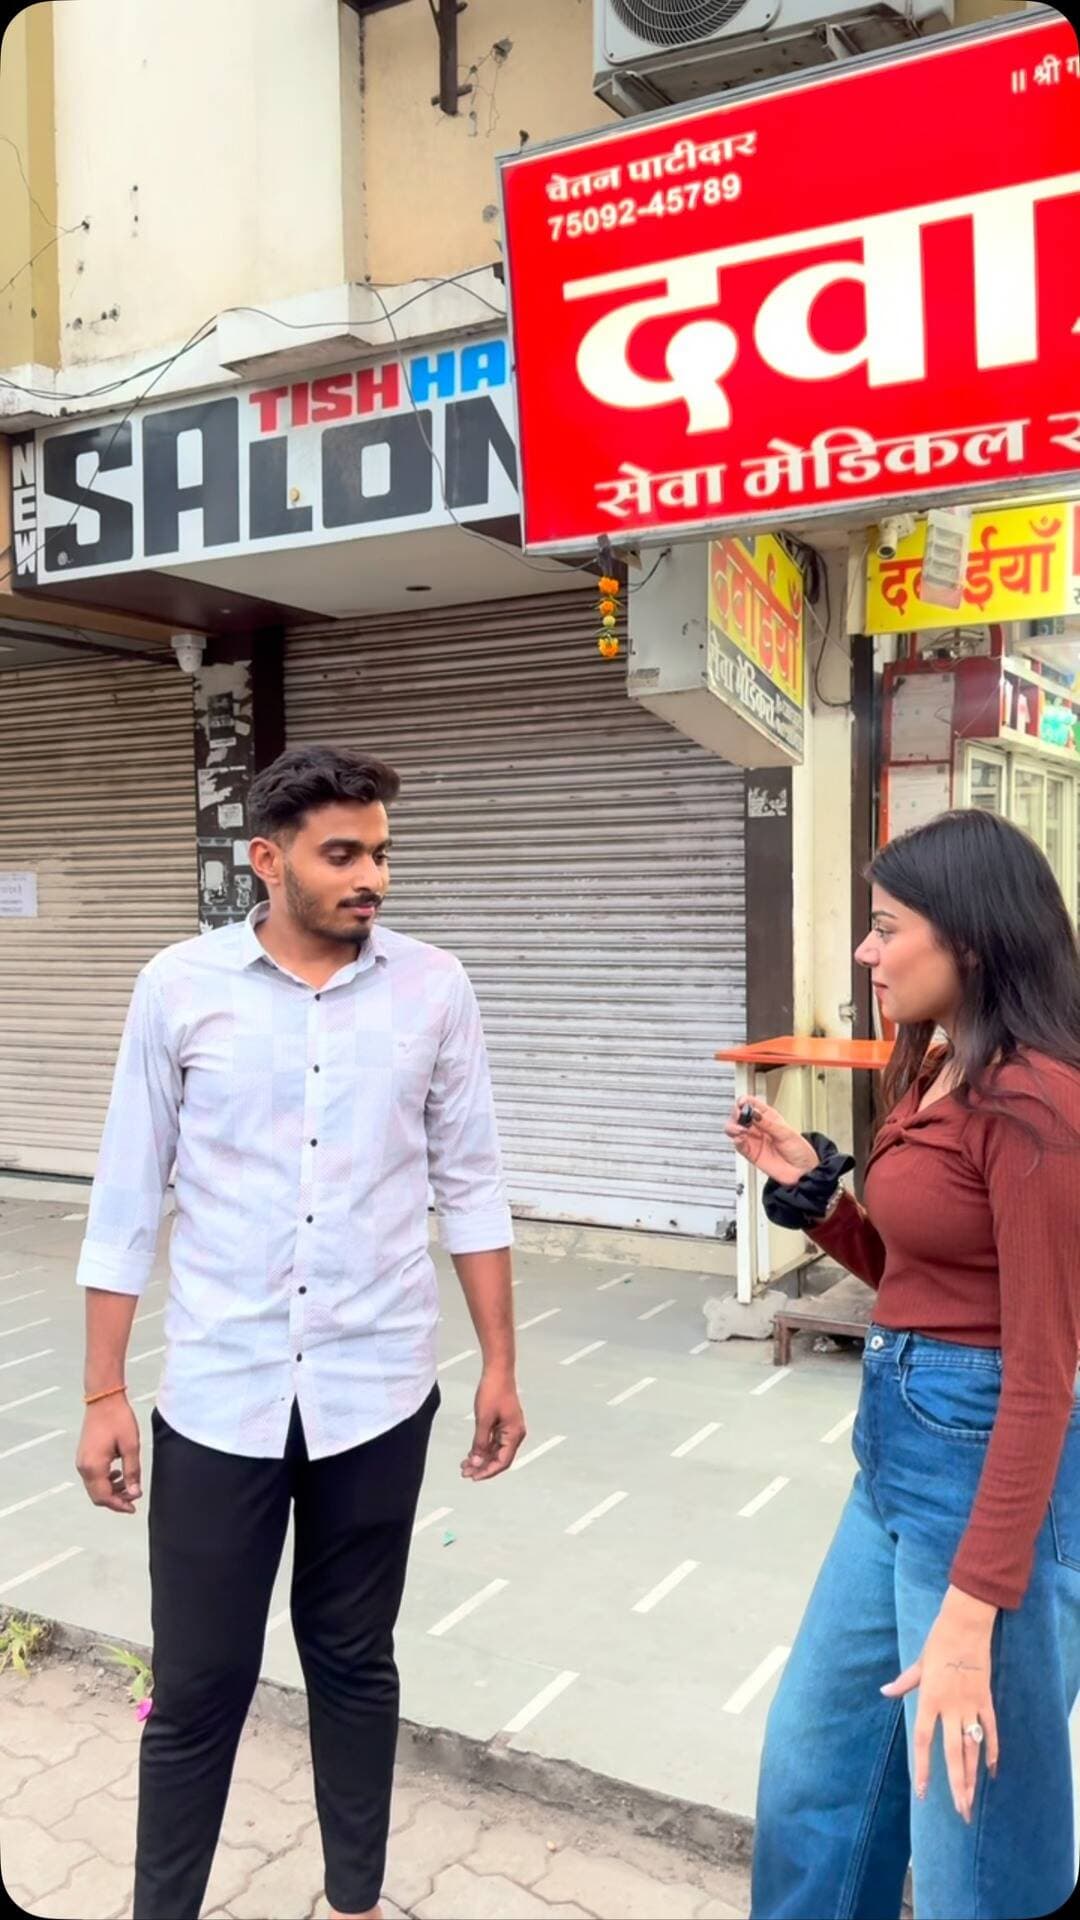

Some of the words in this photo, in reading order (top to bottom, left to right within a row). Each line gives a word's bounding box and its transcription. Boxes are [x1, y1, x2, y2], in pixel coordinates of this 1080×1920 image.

[1033, 53, 1061, 86] श्री
[545, 172, 622, 202] चेतन
[627, 131, 758, 182] पाटीदार
[547, 173, 743, 242] 75092-45789
[562, 172, 1080, 436] दवा
[248, 363, 401, 433] TISH
[12, 441, 37, 576] NEW
[43, 394, 521, 573] SALON
[594, 461, 728, 519] सेवा
[741, 427, 1031, 499] मेडिकल
[879, 516, 1063, 617] दईयाँ
